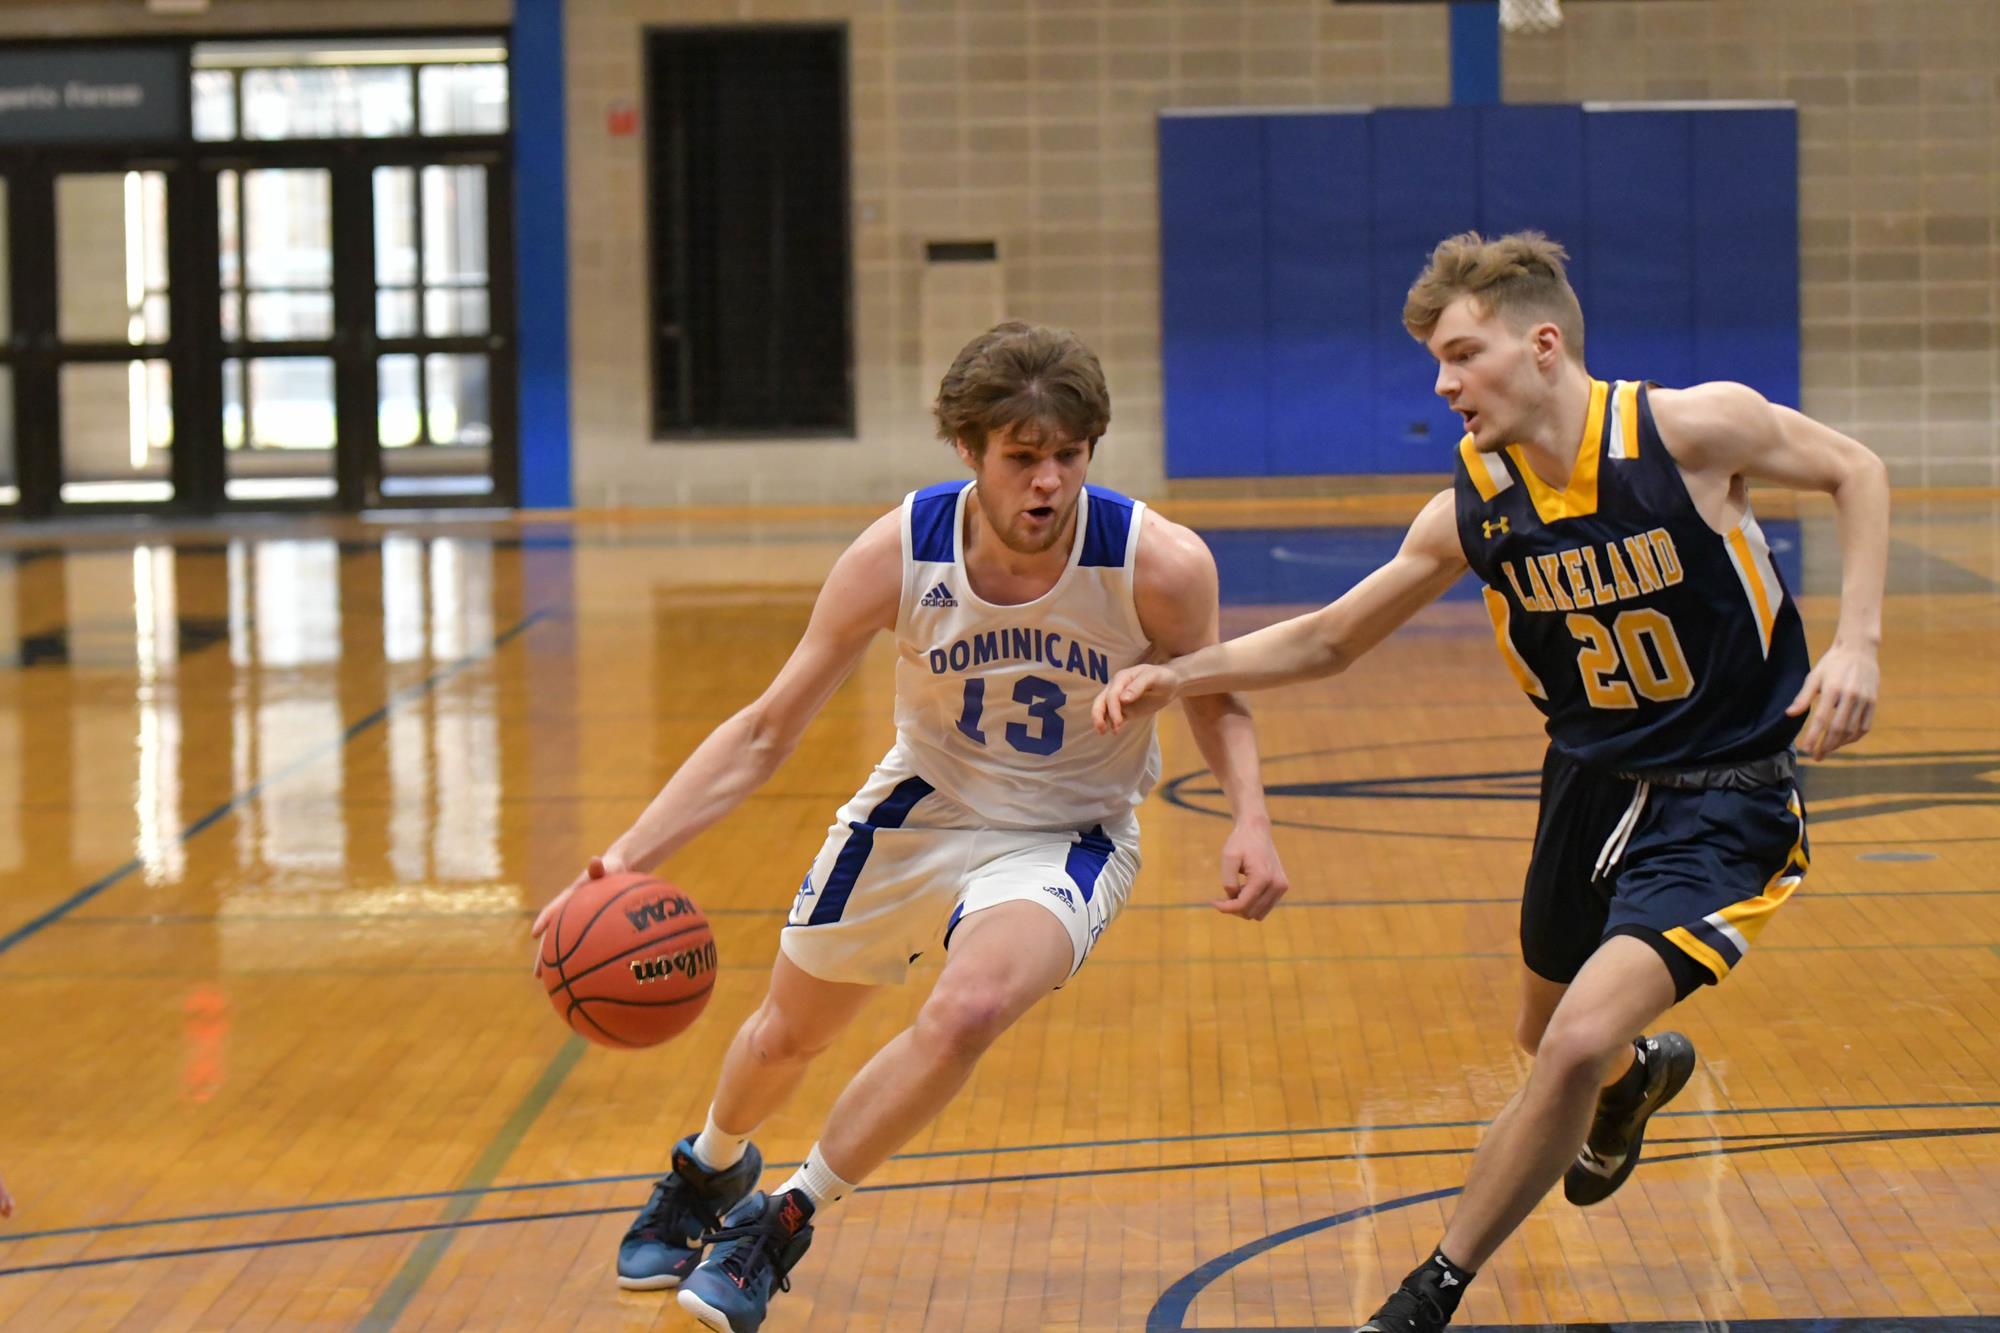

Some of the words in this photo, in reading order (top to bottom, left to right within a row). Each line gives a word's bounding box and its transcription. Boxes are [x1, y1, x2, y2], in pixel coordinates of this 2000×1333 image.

[1501, 527, 1684, 612] LAKELAND
[930, 628, 1109, 685] DOMINICAN
[1565, 607, 1695, 709] 20
[955, 675, 1067, 756] 13
[625, 896, 696, 932] NCAA
[630, 940, 718, 985] Wilson
